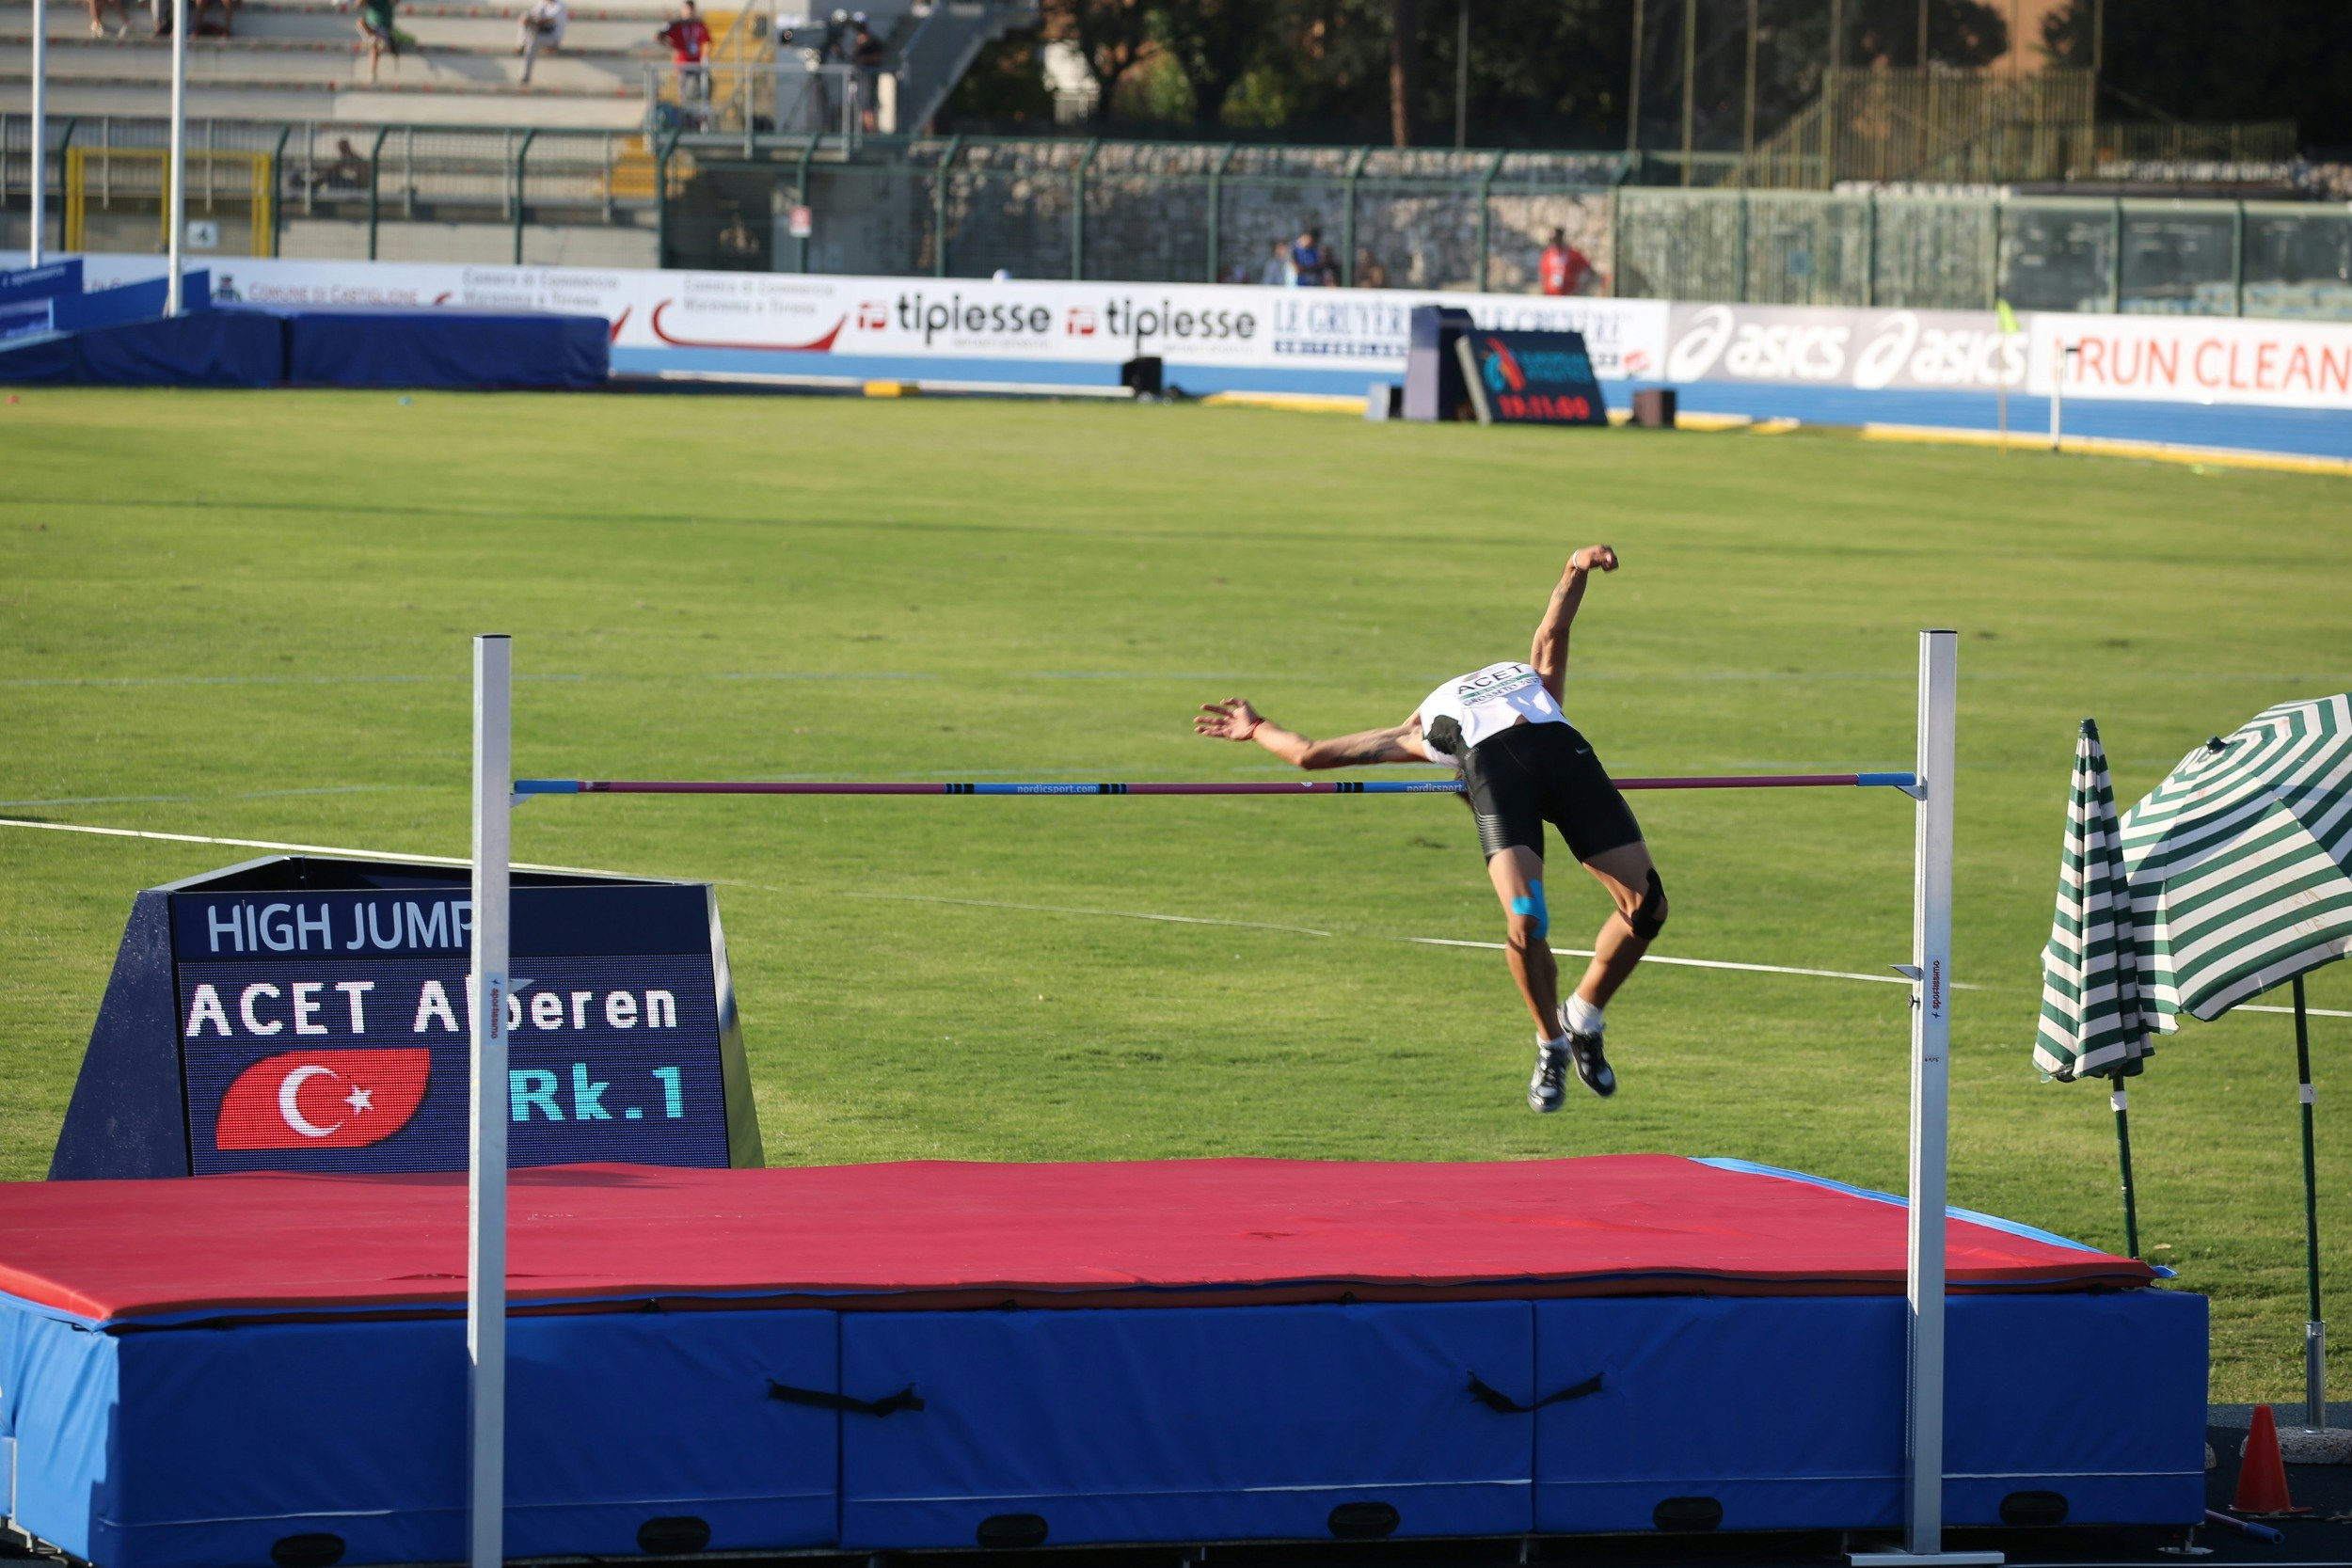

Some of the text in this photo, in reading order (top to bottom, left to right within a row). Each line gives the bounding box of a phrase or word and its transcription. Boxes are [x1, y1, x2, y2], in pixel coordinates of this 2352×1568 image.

[898, 294, 1051, 345] tipiesse
[1106, 300, 1256, 356] tipiesse
[1724, 323, 1851, 379] asics
[1910, 328, 2030, 387] asics
[2076, 336, 2181, 386] RUN
[2193, 337, 2352, 393] CLEAN
[1458, 663, 1523, 694] ACET
[1017, 784, 1097, 794] nordicsport.com
[1406, 783, 1467, 793] nordicsport.
[208, 900, 472, 952] HIGH JUMP
[186, 981, 374, 1037] ACET
[1932, 959, 1941, 1010] sportissimo
[490, 988, 500, 1039] sportissimo
[509, 1062, 684, 1121] Rk.1
